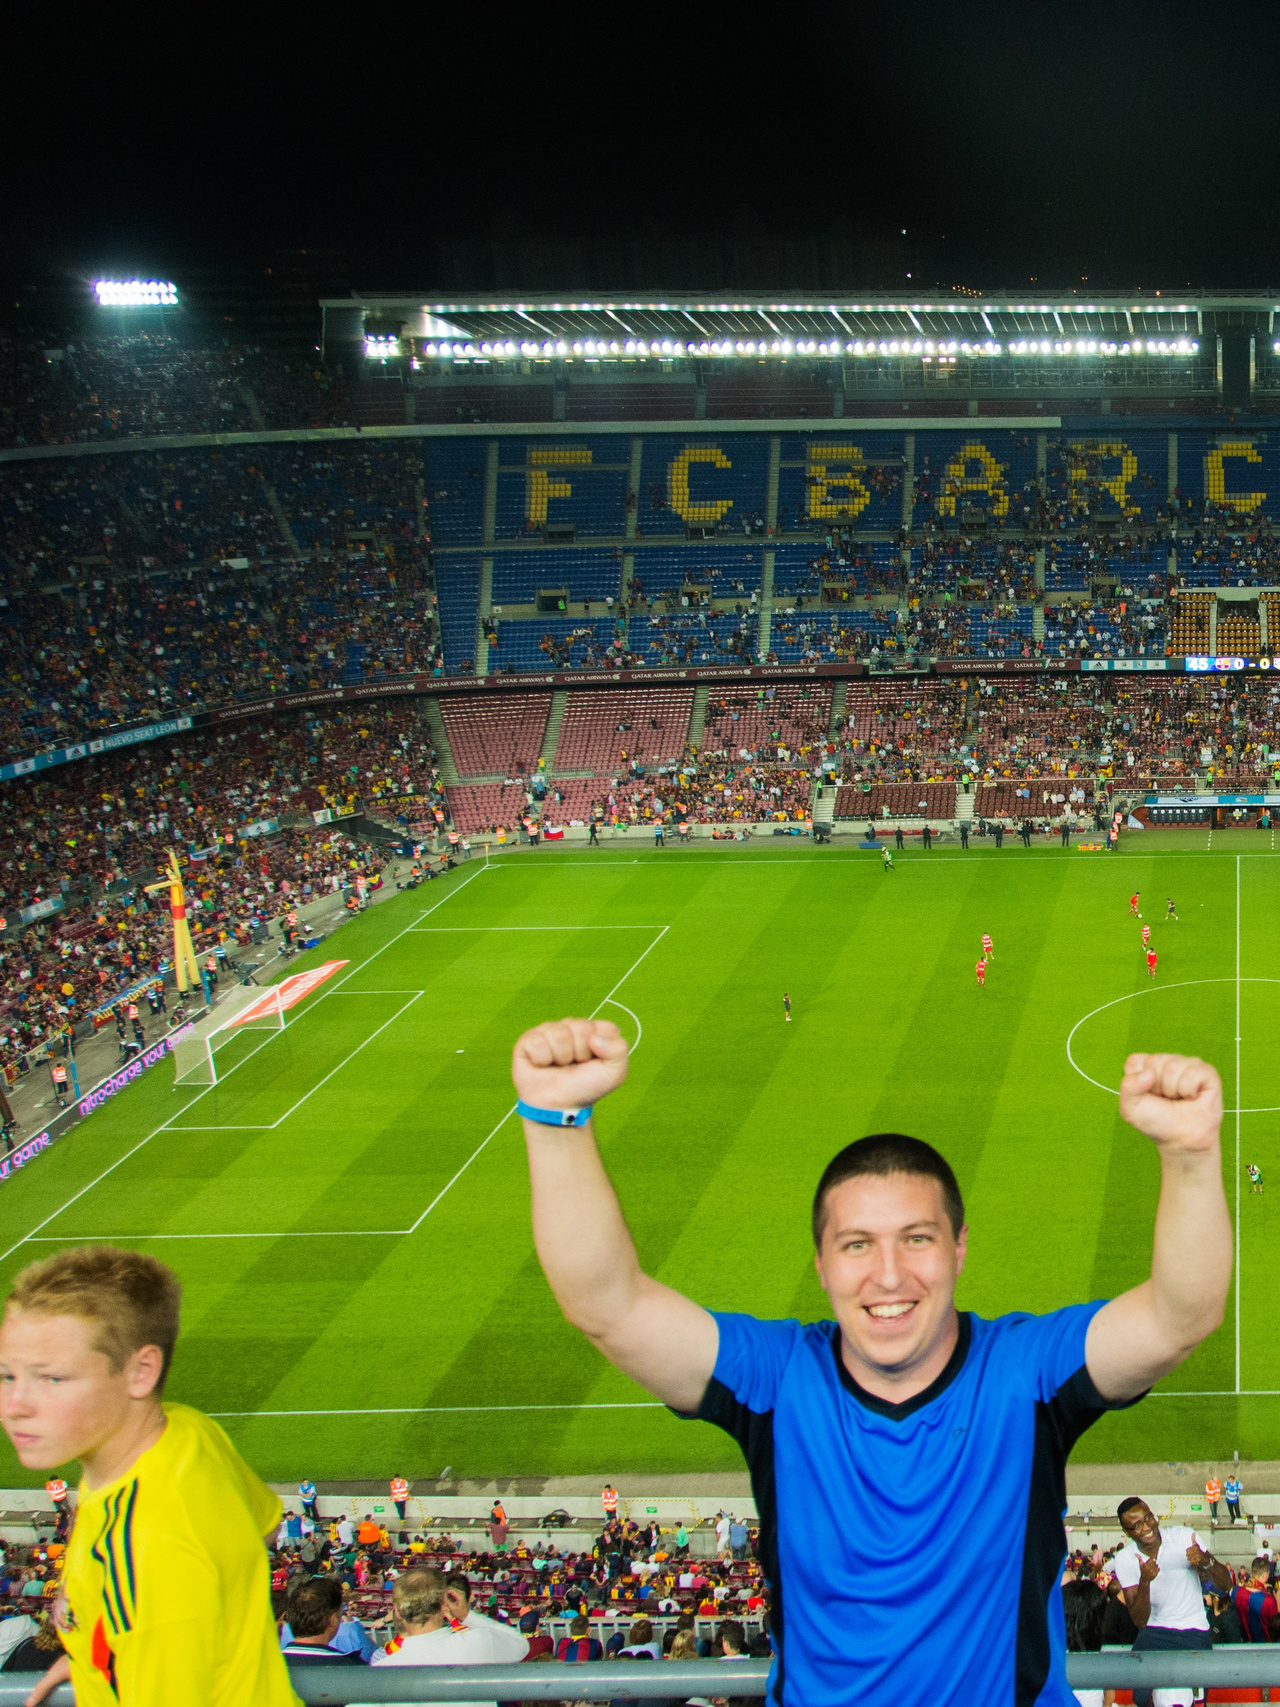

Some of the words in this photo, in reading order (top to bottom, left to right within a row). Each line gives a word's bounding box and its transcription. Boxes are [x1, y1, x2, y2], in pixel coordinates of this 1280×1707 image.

[1188, 658, 1209, 670] 45
[1234, 658, 1245, 670] 0
[1259, 658, 1270, 670] 0
[518, 676, 545, 684] AIRWAYS
[631, 672, 652, 680] QATAR
[355, 687, 377, 696] QATAR
[378, 684, 406, 692] AIRWAYS
[427, 681, 448, 689] QATAR
[449, 679, 477, 687] AIRWAYS
[285, 696, 307, 706] QATAR
[307, 692, 334, 701] AIRWAYS
[219, 709, 240, 718] QATAR
[105, 733, 134, 749] NUEVO
[134, 728, 154, 740] SEAT
[79, 1060, 142, 1116] nitrocharge
[142, 1042, 166, 1067] your
[12, 1131, 51, 1168] game
